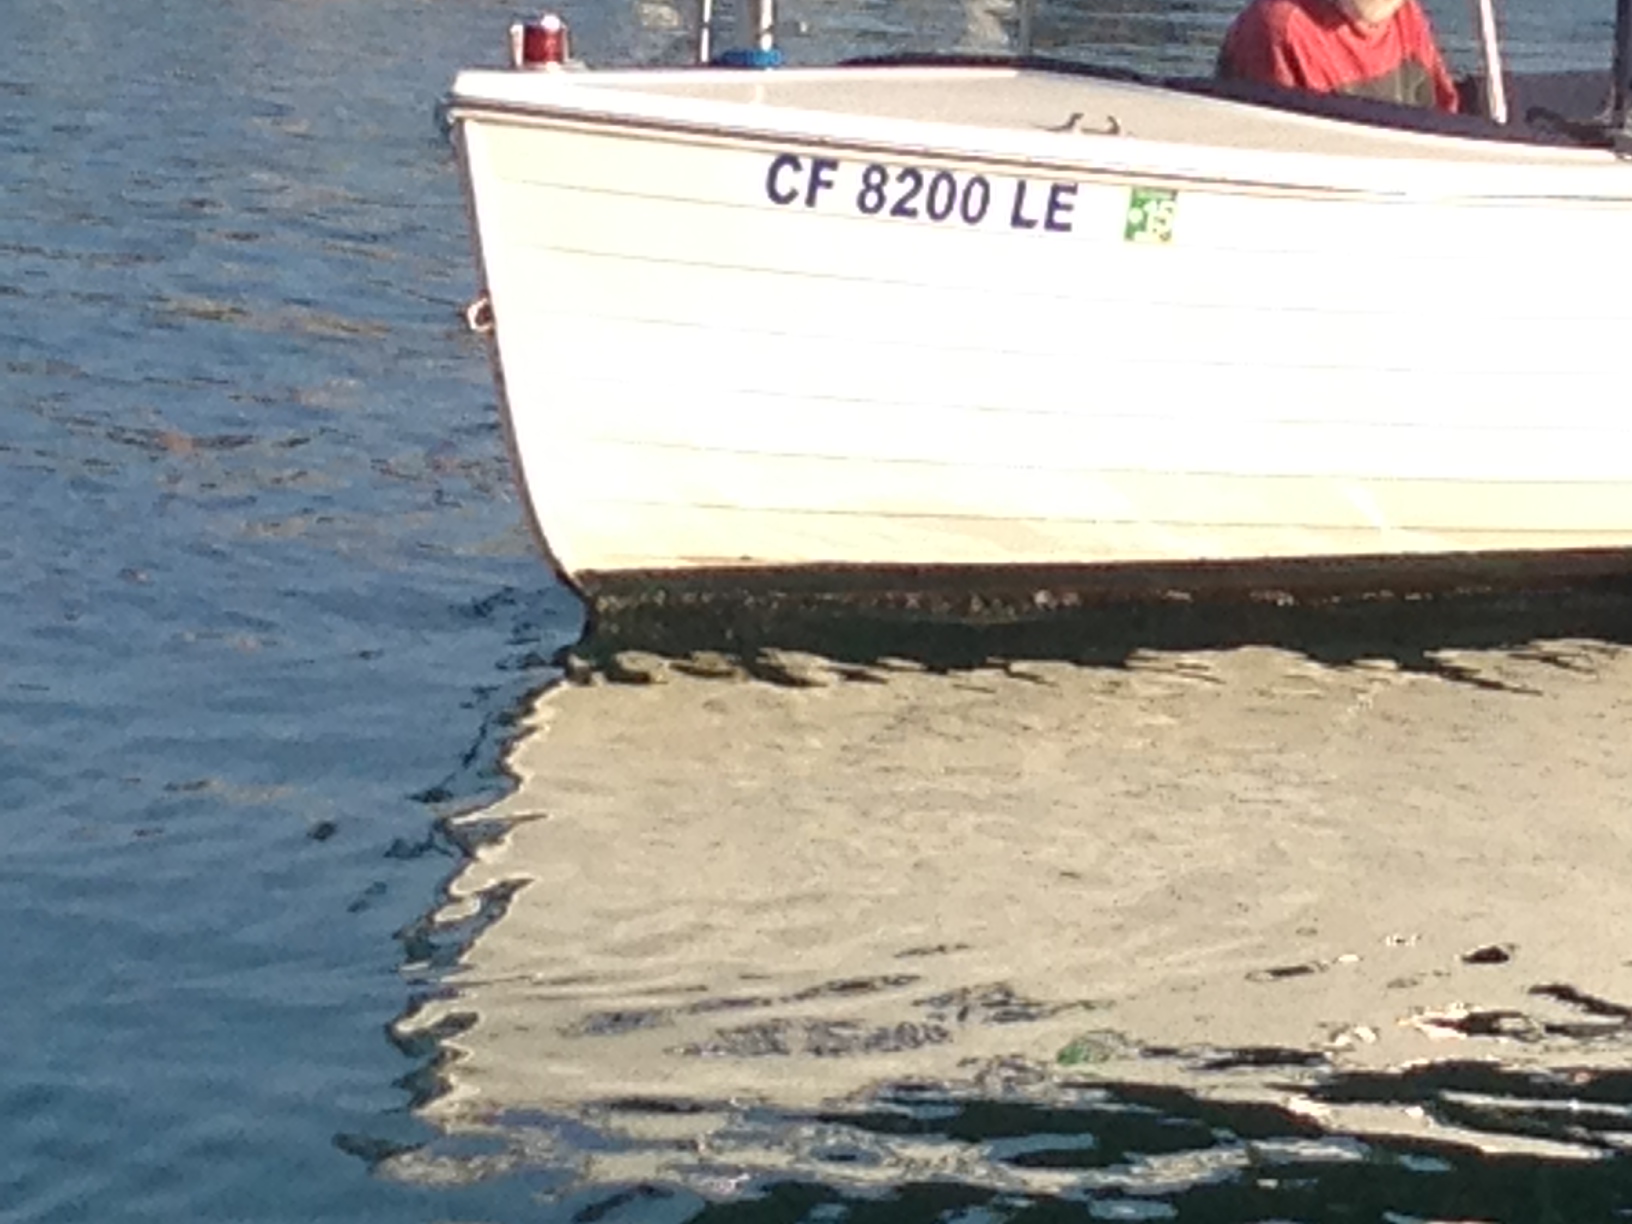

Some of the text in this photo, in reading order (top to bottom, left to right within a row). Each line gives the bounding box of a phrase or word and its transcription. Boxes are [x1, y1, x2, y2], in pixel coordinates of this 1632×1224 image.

[766, 152, 1078, 232] CF 8200 LE
